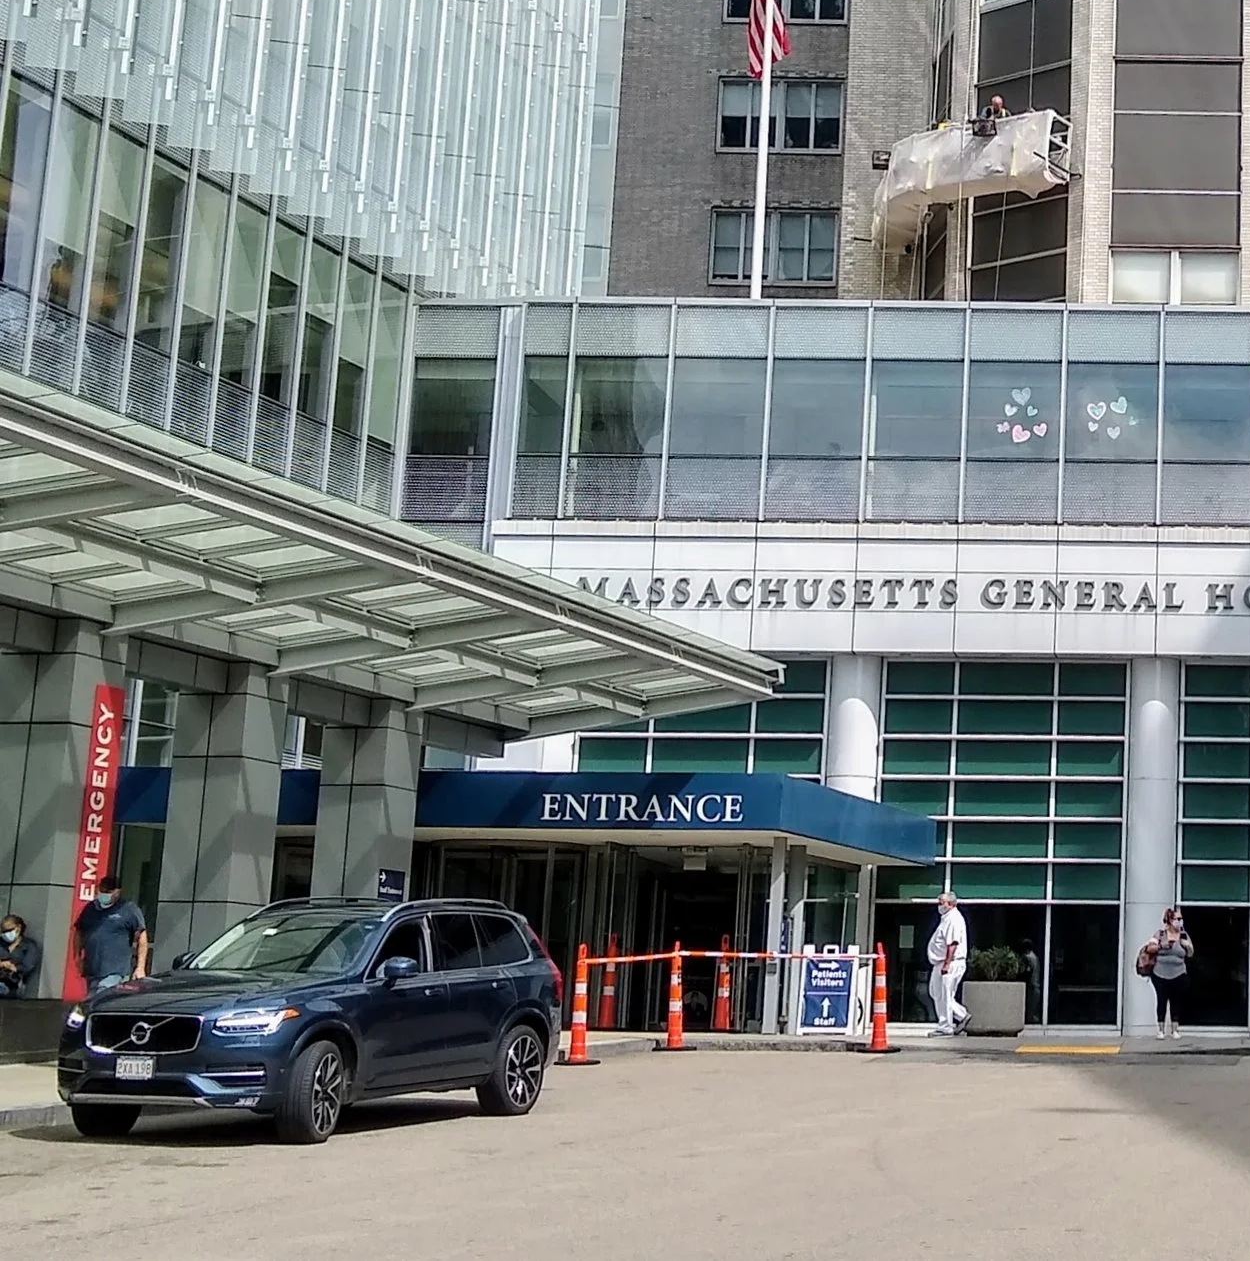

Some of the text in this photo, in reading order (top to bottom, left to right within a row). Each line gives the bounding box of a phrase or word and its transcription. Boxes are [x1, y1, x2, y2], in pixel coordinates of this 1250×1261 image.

[575, 576, 959, 610] MASSACHUSETTS
[980, 578, 1185, 613] GENERAL
[79, 702, 115, 902] EMERGENCY
[540, 793, 744, 823] ENTRANCE
[811, 969, 847, 978] Patients
[811, 978, 844, 987] Visitors
[813, 1017, 835, 1025] Staff
